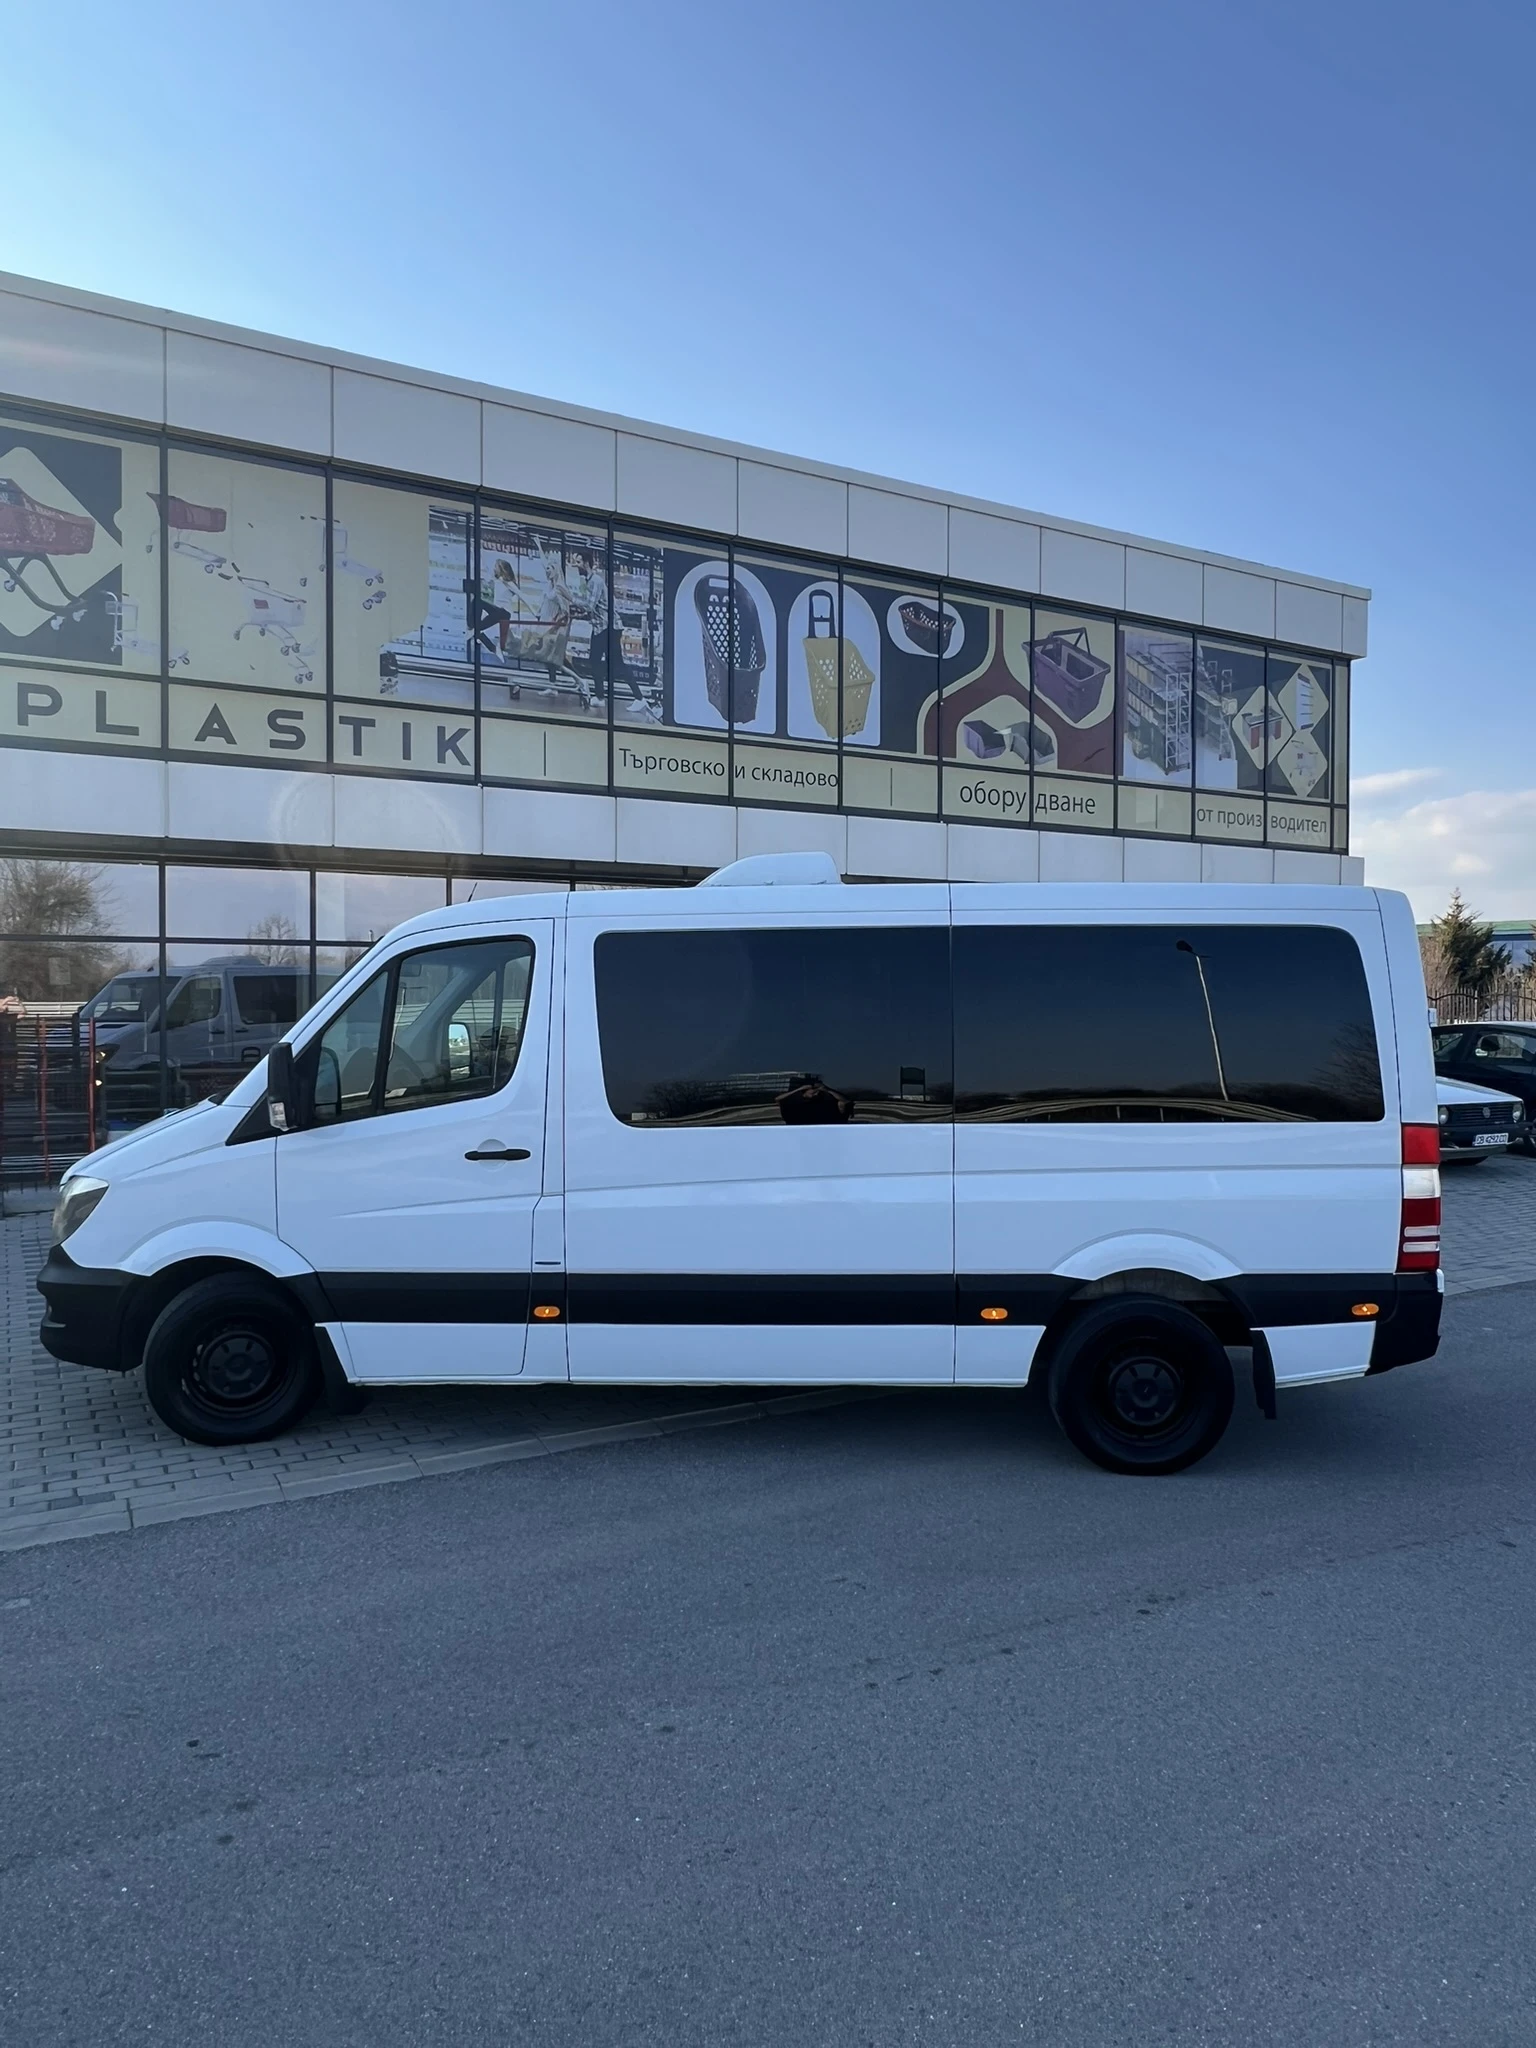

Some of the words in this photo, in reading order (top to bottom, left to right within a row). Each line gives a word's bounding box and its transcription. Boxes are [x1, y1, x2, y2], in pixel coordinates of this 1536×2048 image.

[16, 681, 472, 767] PLASTIK
[618, 748, 725, 777] Търговско
[734, 764, 746, 780] и
[751, 766, 839, 788] складово
[1196, 808, 1214, 822] от
